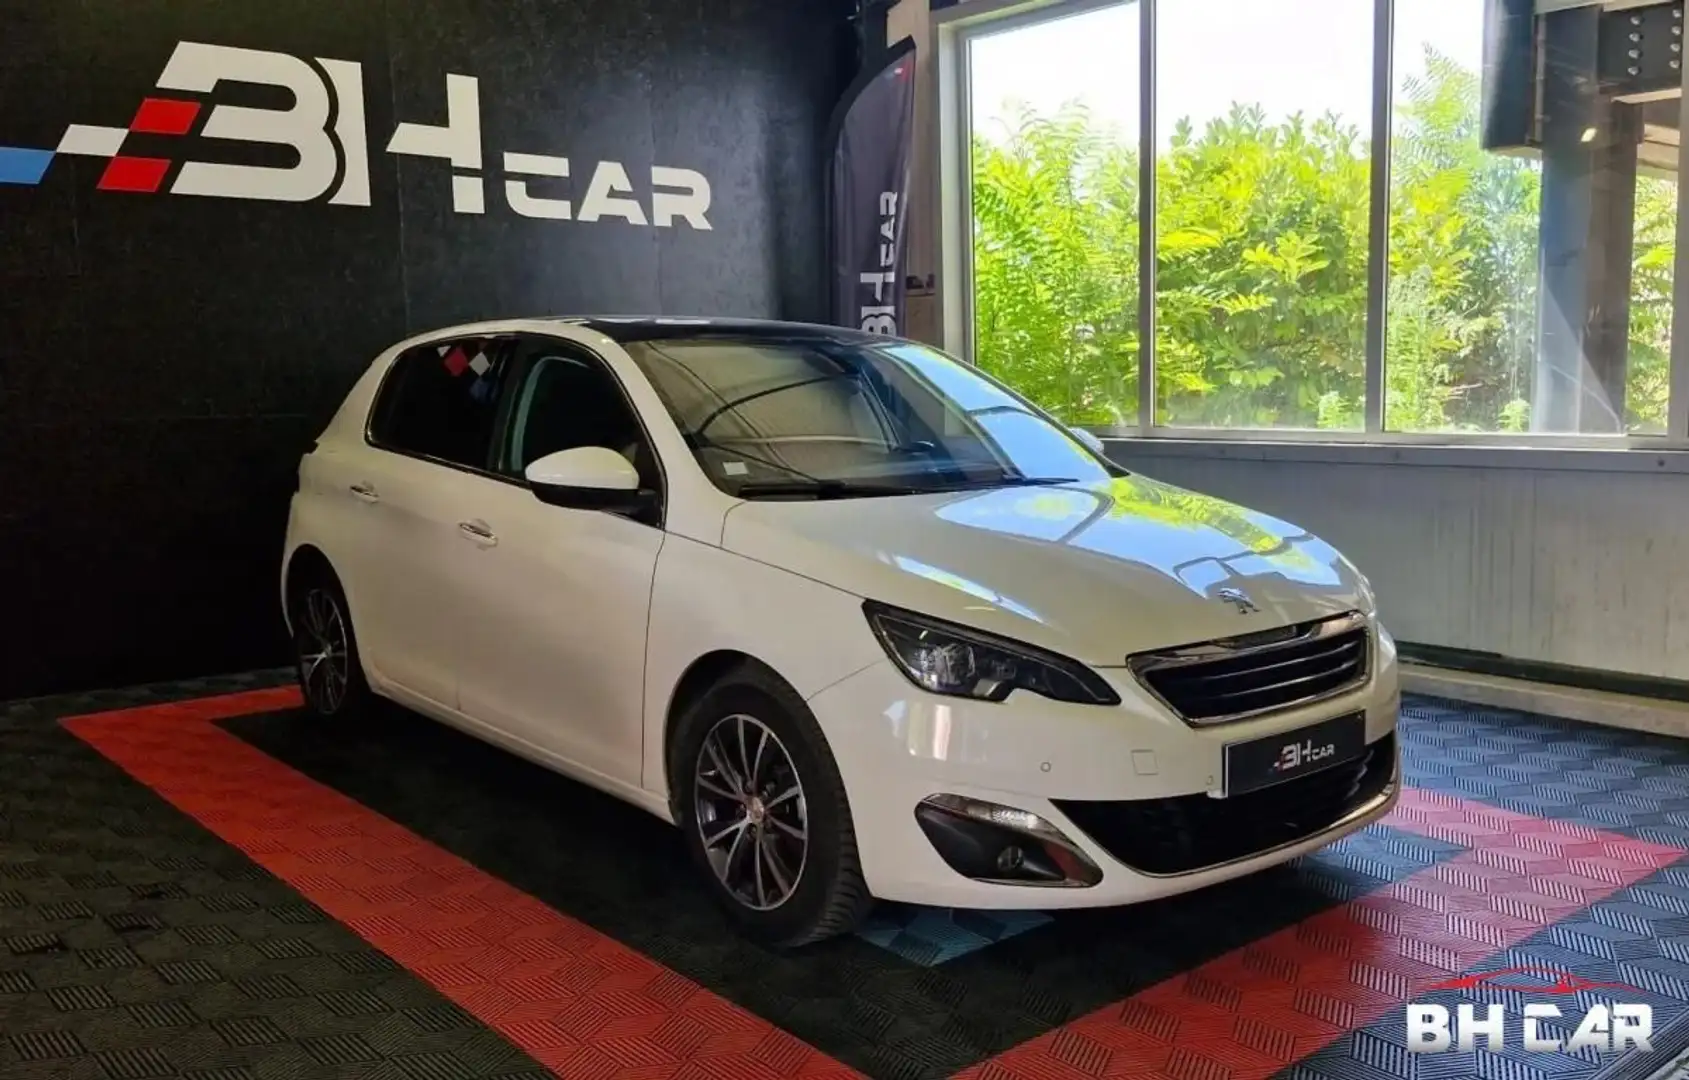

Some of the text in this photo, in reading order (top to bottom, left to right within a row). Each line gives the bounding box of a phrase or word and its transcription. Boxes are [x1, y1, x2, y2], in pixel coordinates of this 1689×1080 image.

[503, 151, 713, 231] CAR
[879, 191, 898, 268] CAR
[1313, 744, 1335, 760] CAR
